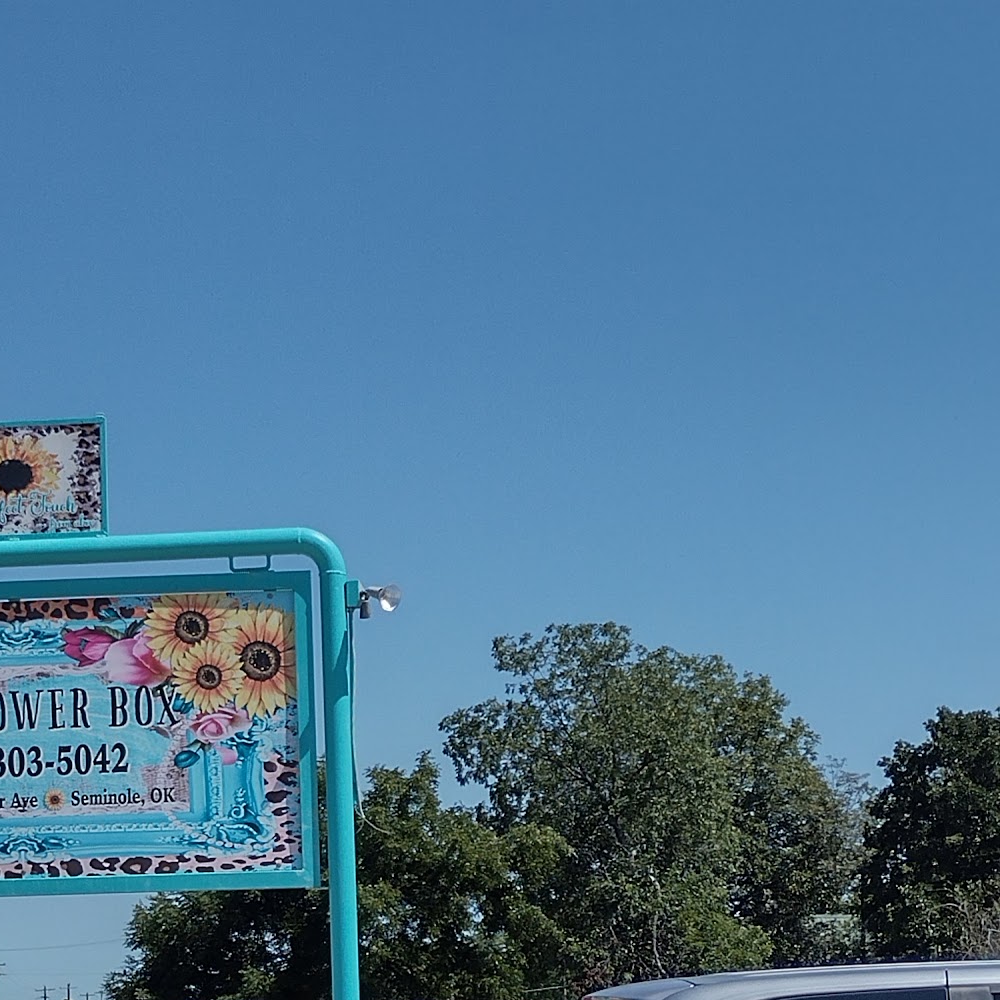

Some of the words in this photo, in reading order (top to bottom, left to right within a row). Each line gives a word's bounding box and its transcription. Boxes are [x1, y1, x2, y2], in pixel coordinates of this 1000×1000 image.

[30, 491, 77, 516] Touch
[107, 685, 181, 728] BOX
[71, 788, 145, 807] Seminole,
[150, 787, 176, 804] OK
